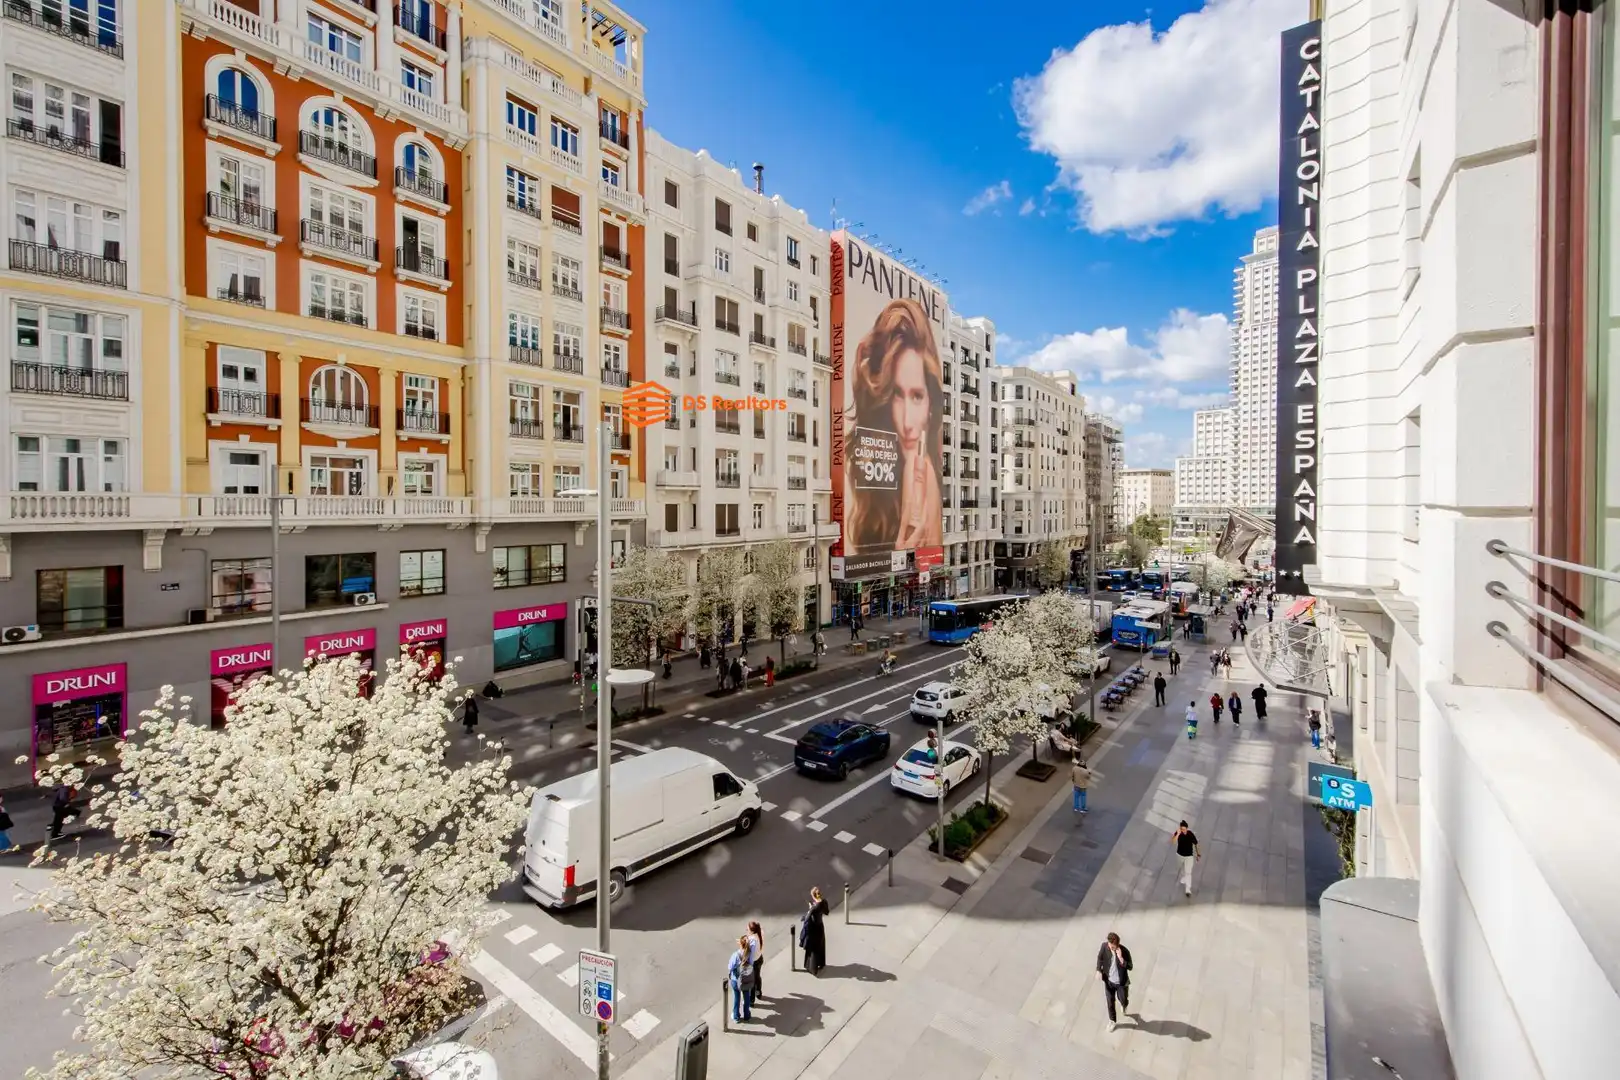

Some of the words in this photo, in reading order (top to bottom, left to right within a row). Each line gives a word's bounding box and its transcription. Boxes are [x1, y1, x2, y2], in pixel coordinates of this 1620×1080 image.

[1297, 38, 1320, 251] CATALONIA
[833, 241, 843, 296] PANTEN
[848, 239, 940, 323] PANTENE
[1294, 268, 1317, 388] PLAZA
[833, 321, 843, 381] PANTENE
[833, 407, 843, 466] PANTENE
[860, 436, 886, 449] REDUCE
[886, 440, 893, 449] LA
[855, 446, 874, 459] CAÍDA
[875, 450, 884, 459] DE
[884, 451, 898, 461] PELO
[1293, 404, 1316, 544] ESPAÑA
[518, 609, 547, 622] DRUNI
[405, 624, 443, 639] DRUNI
[320, 636, 364, 652] DRUNI
[218, 650, 271, 668] DRUNI
[47, 671, 116, 695] DRUNI
[1329, 796, 1355, 808] ATM
